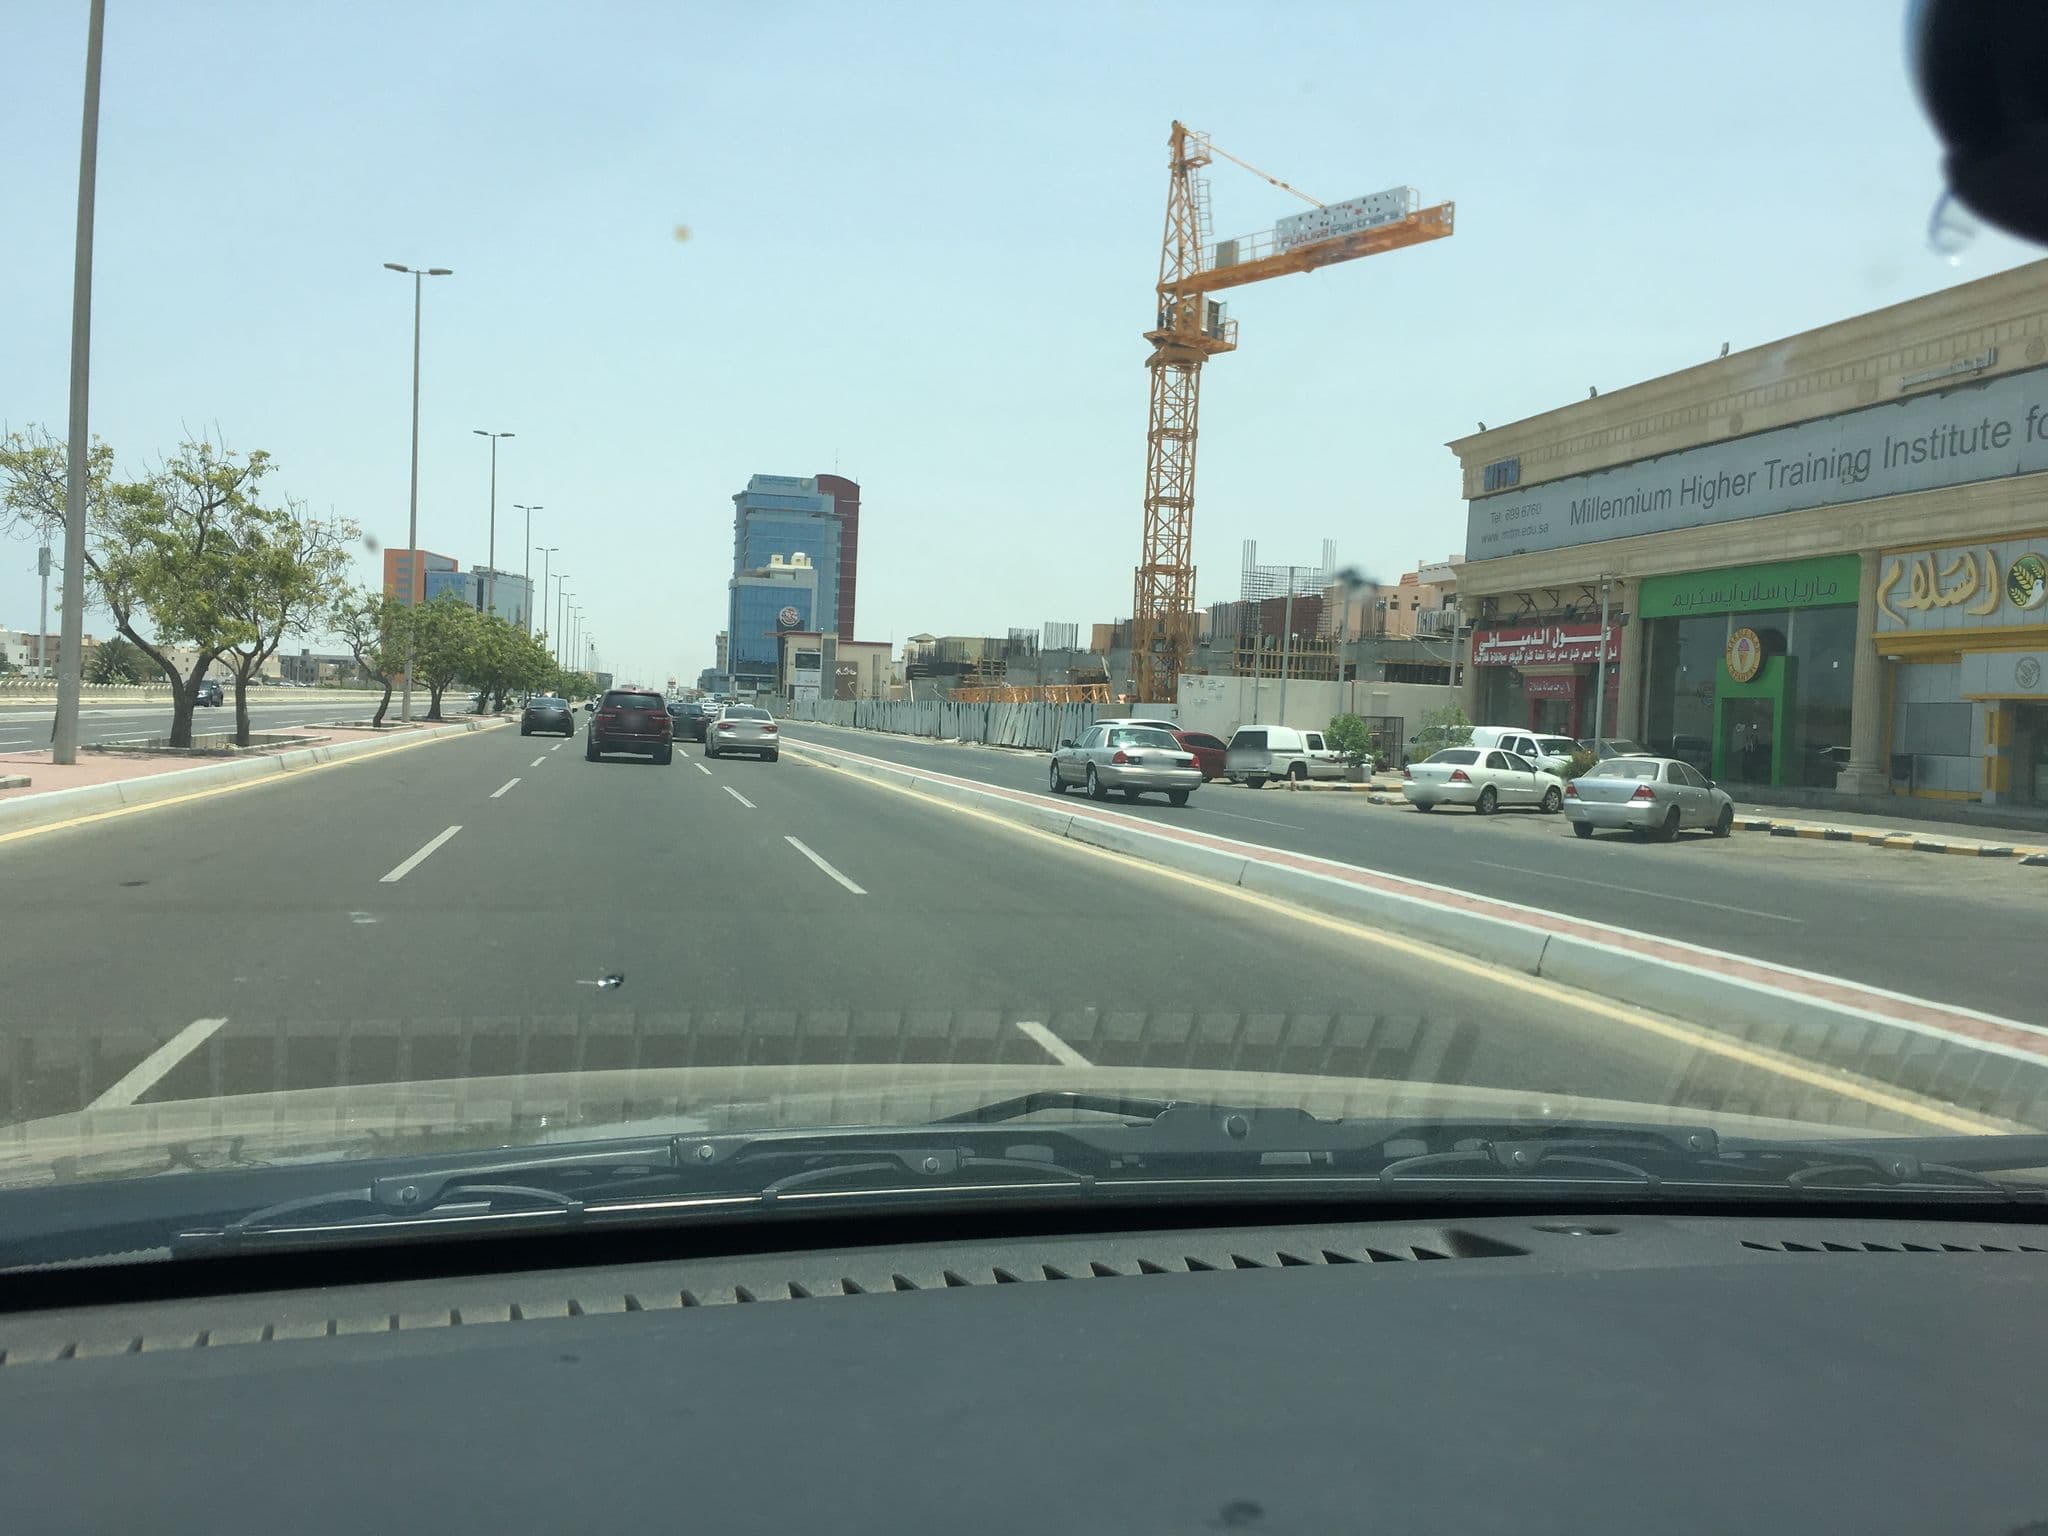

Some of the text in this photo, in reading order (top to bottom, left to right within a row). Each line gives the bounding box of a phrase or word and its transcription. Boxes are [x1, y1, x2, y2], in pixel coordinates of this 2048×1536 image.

[1569, 488, 1672, 526] Millennium
[1680, 470, 1757, 511] Higher
[1764, 446, 1873, 492] Training
[1883, 419, 2013, 470] Institute
[1740, 581, 1780, 607] سلاب
[1785, 576, 1838, 603] ماربل
[1877, 549, 2000, 625] السلام
